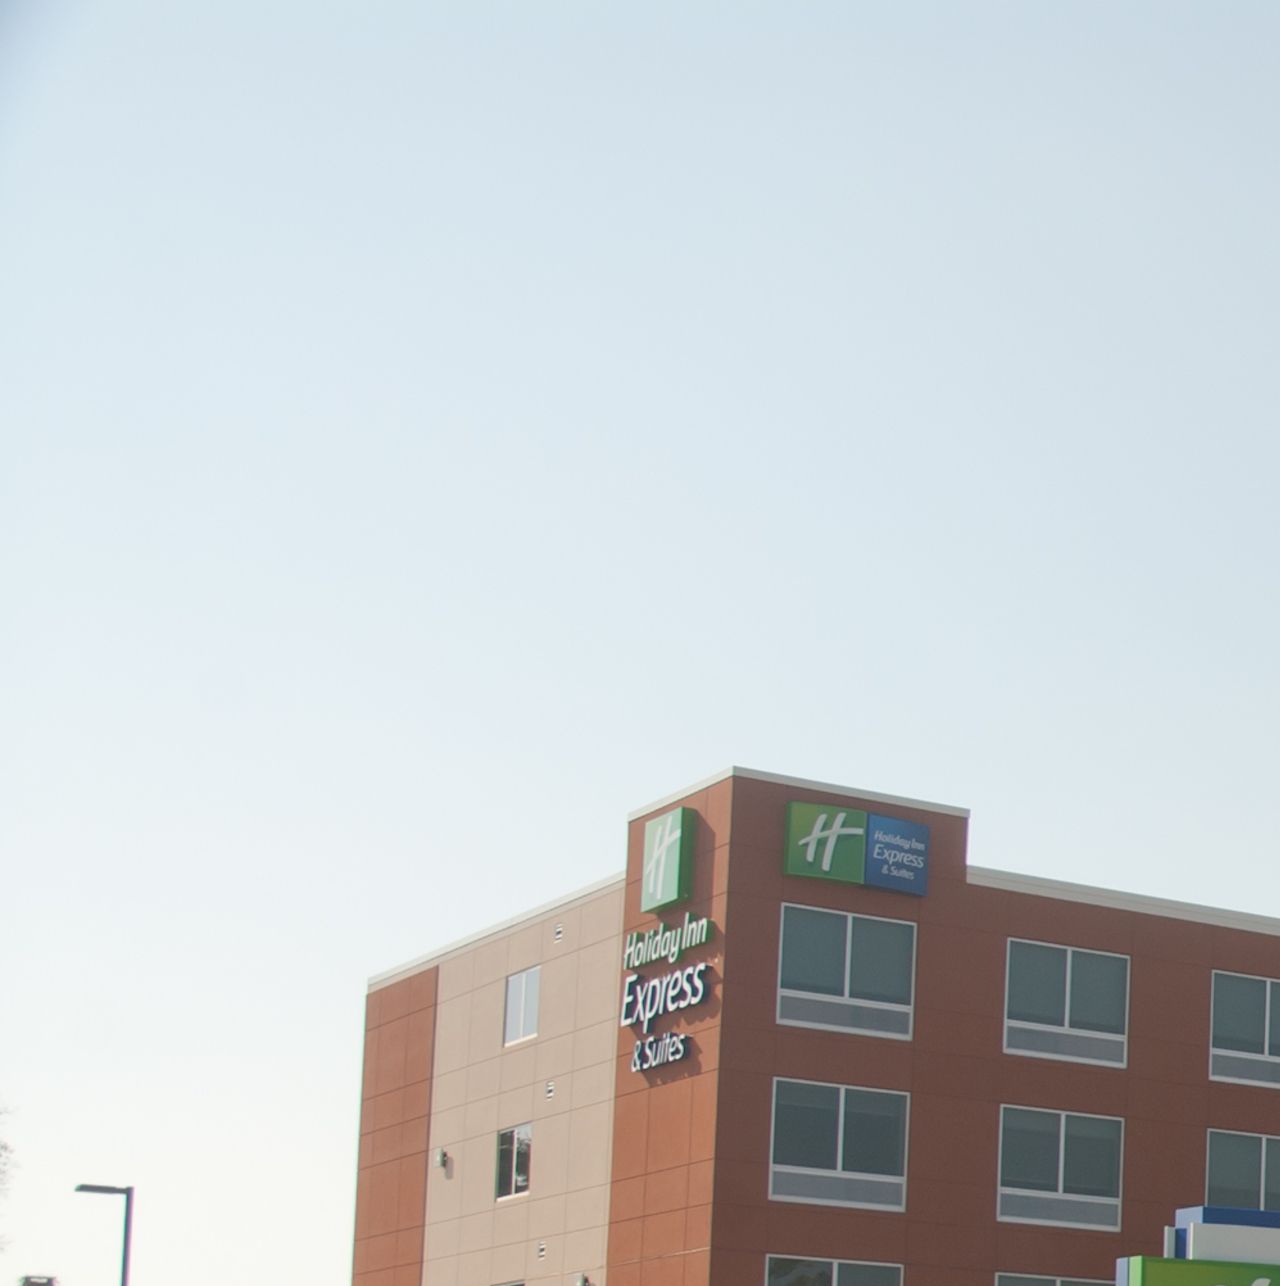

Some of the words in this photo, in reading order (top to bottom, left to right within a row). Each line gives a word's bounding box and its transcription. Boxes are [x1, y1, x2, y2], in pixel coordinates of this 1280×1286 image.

[873, 843, 924, 868] Express
[874, 830, 911, 850] Holiday
[911, 838, 925, 850] Inn
[881, 864, 889, 874] &
[889, 866, 914, 880] Suites
[623, 922, 682, 970] Holiday
[681, 912, 708, 950] Inn
[620, 962, 707, 1034] Express
[631, 1039, 642, 1072] &
[642, 1031, 686, 1070] Suites
